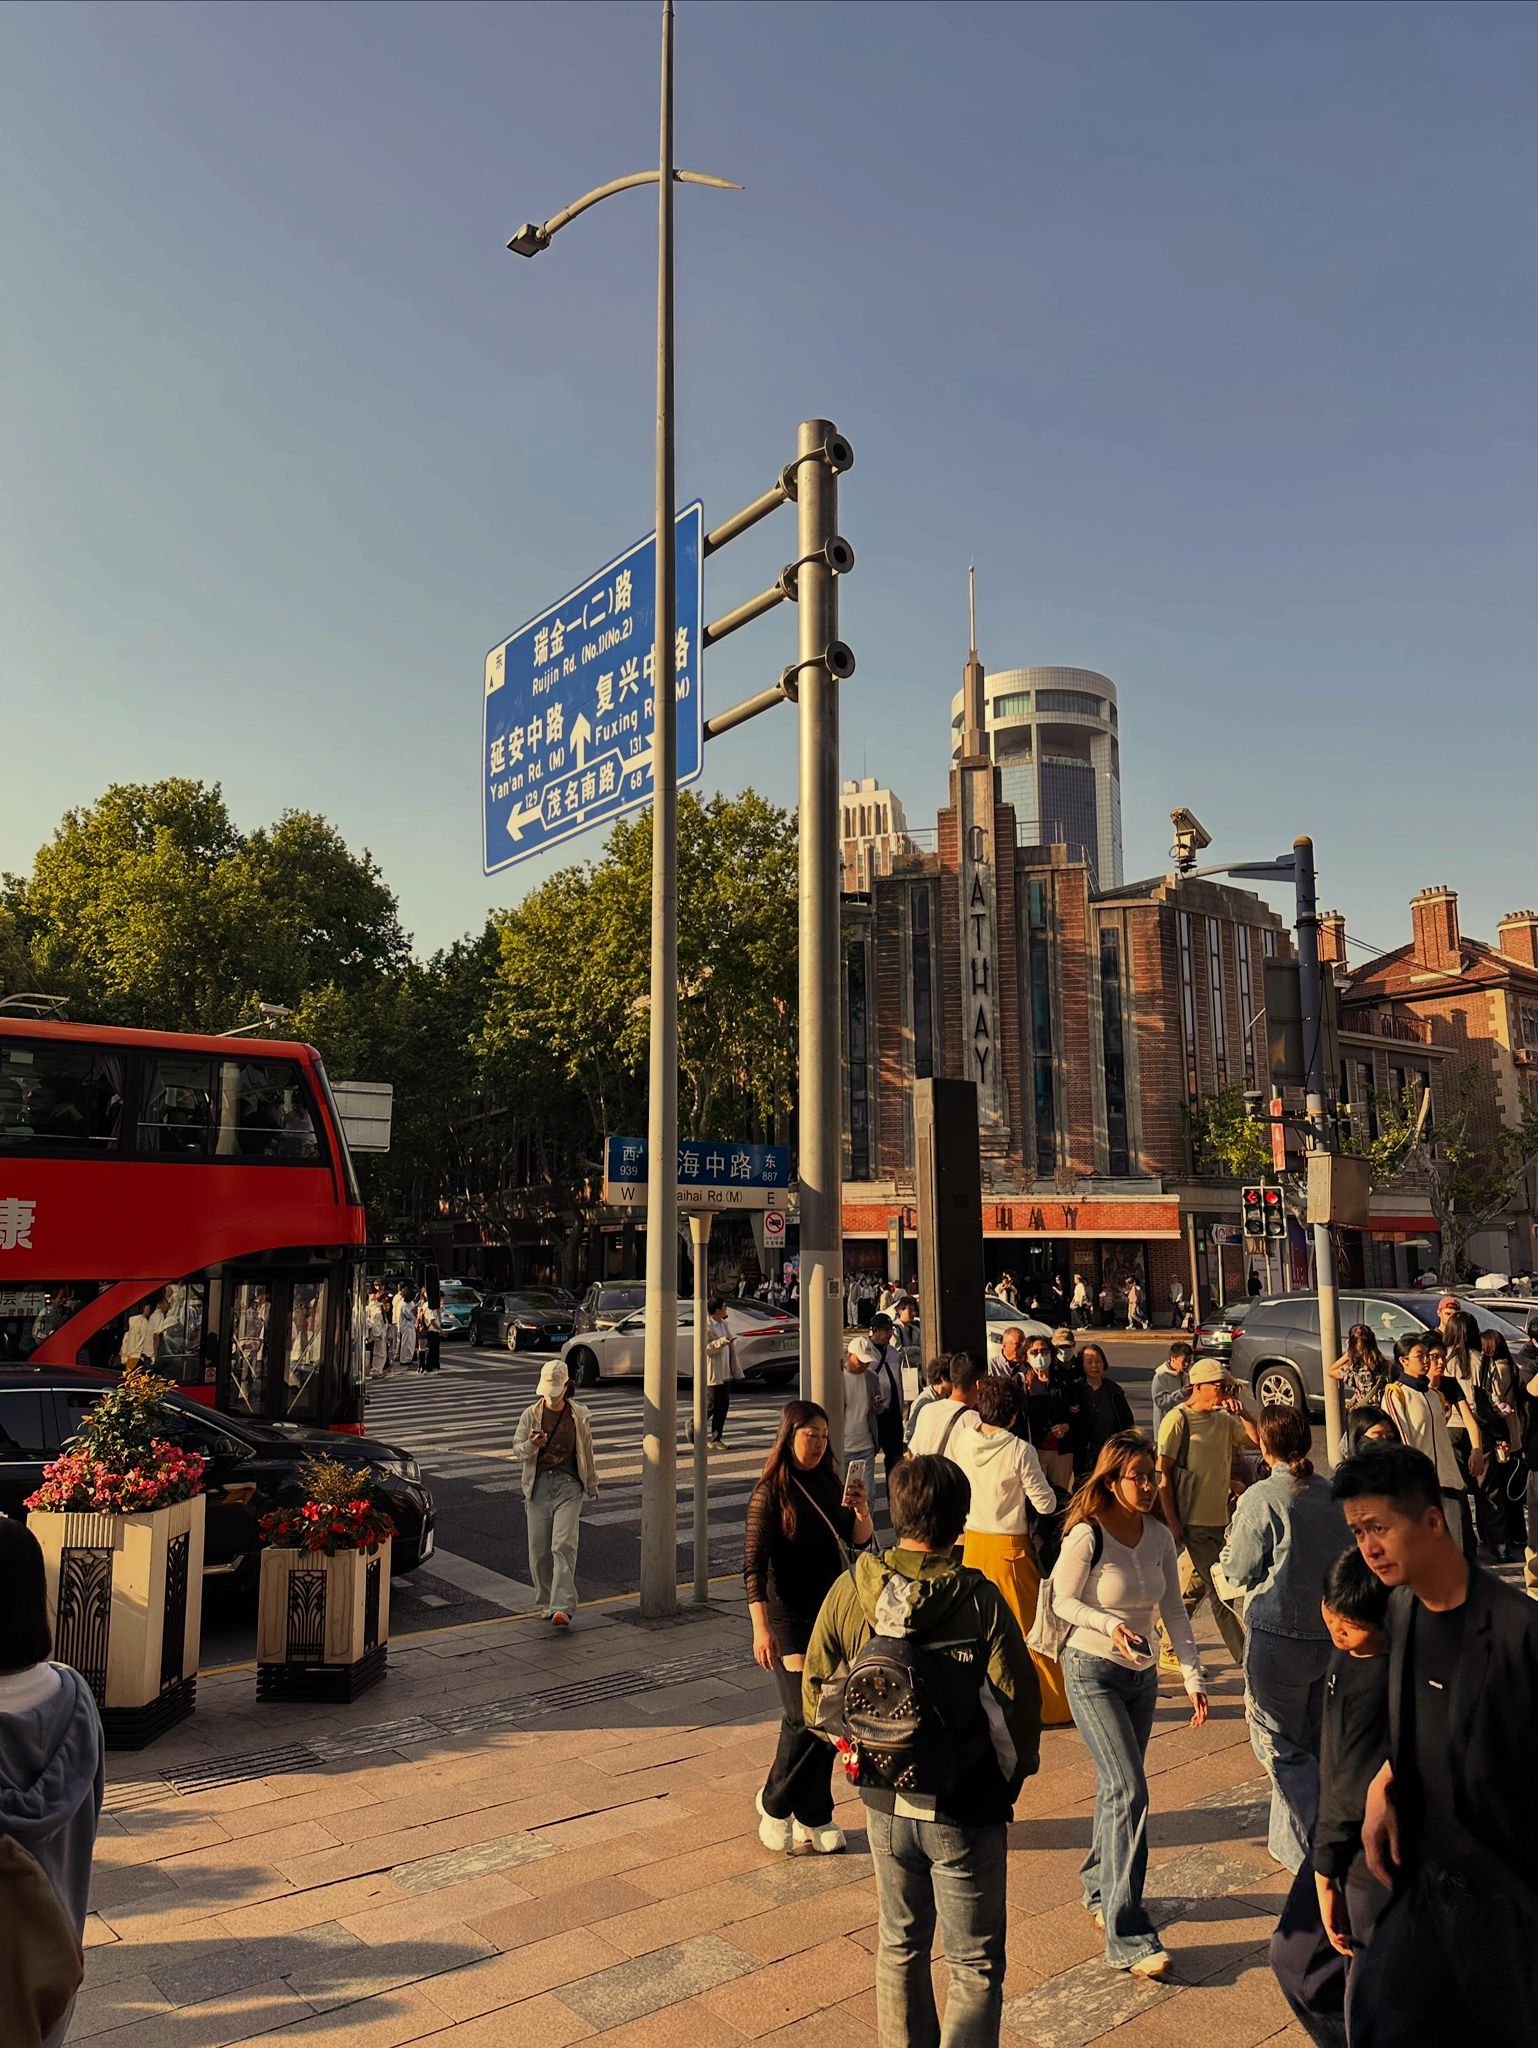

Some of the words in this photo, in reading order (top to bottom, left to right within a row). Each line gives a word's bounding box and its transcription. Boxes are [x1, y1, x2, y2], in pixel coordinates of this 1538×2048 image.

[534, 569, 632, 667] 瑞金一(二)路
[533, 667, 559, 696] Ruijin
[563, 654, 577, 677] Rd.
[595, 709, 638, 746] Fuxing
[644, 697, 655, 719] R
[675, 676, 690, 703] M)
[490, 702, 564, 776] 延安中路
[629, 734, 642, 756] 131
[490, 773, 524, 802] Yan'an
[528, 760, 544, 783] Rd.
[549, 747, 565, 772] (M)
[630, 770, 642, 790] 68
[525, 790, 538, 809] 129
[546, 760, 615, 821] 茂名南路
[968, 825, 989, 1083] CATHAY
[622, 1145, 637, 1162] 西
[764, 1153, 777, 1169] 东
[619, 1165, 638, 1176] 939
[677, 1149, 752, 1180] 海中路
[762, 1171, 778, 1182] 887
[621, 1187, 635, 1201] W
[677, 1189, 703, 1202] aihai
[767, 1192, 776, 1205] E
